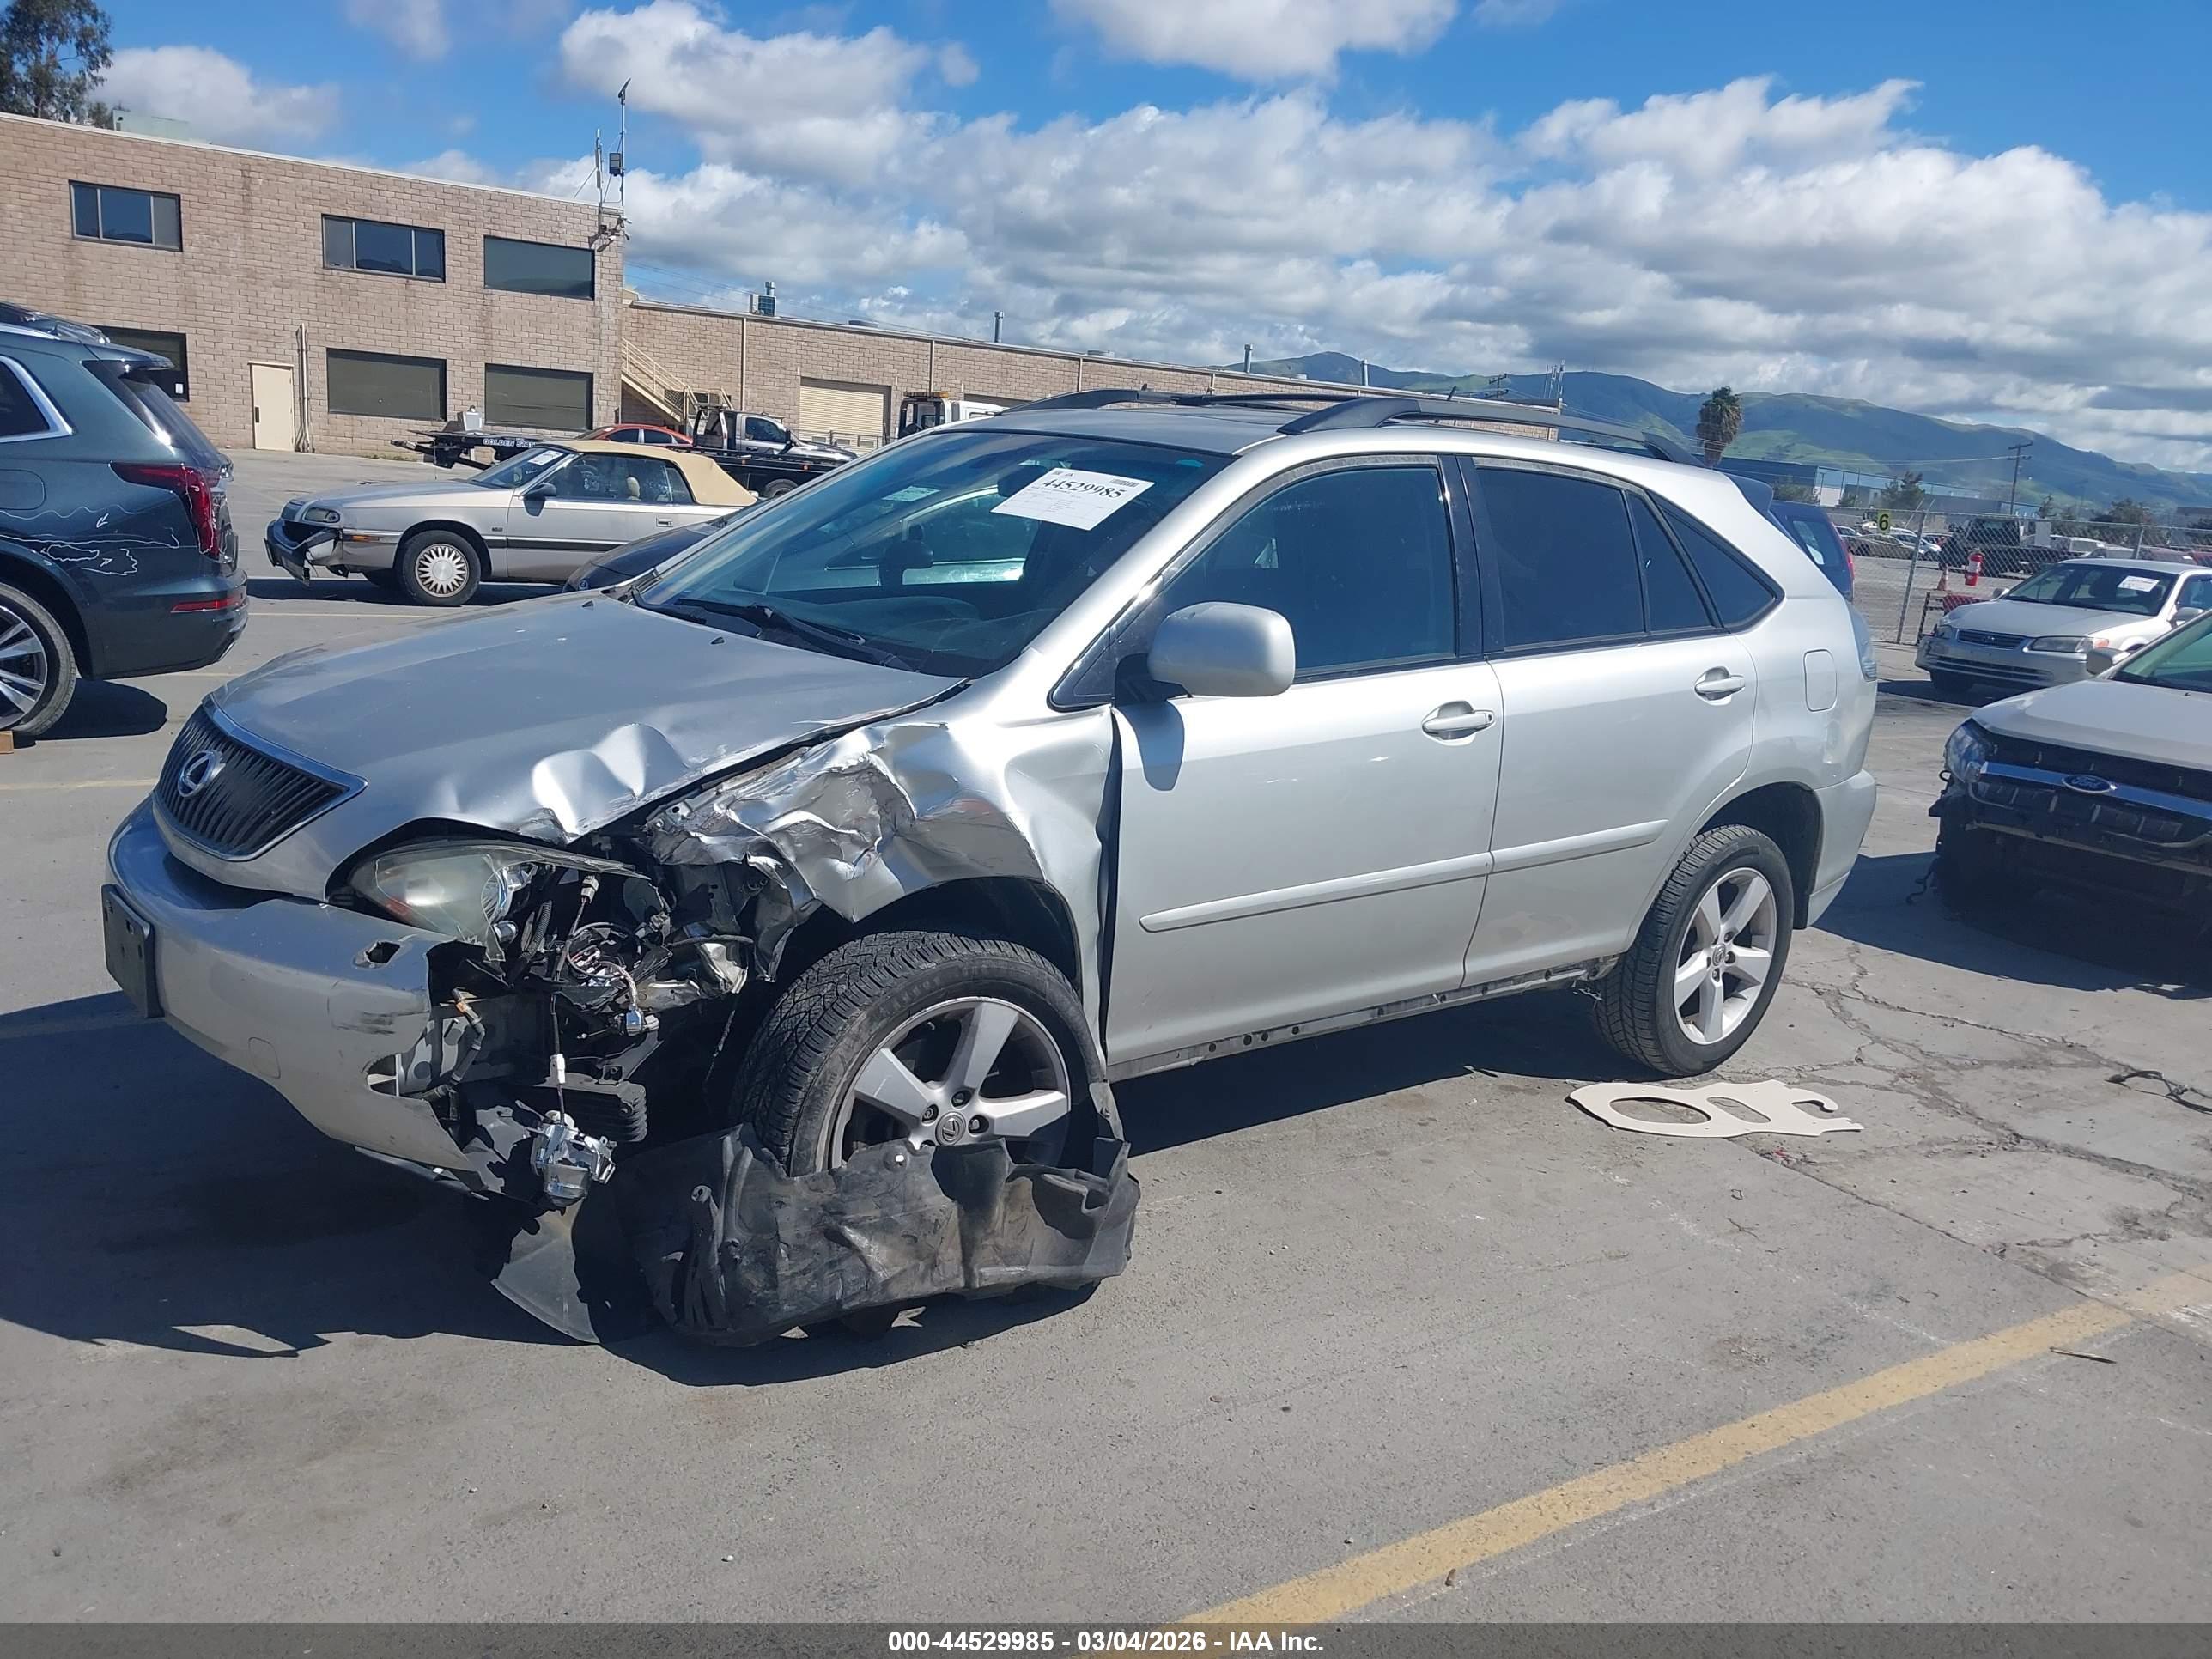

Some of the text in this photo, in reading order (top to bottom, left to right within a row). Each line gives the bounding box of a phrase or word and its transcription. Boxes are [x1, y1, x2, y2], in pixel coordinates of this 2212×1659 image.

[483, 438, 515, 447] GOLDEN
[1043, 479, 1127, 498] 44529985
[1879, 514, 1889, 531] 6
